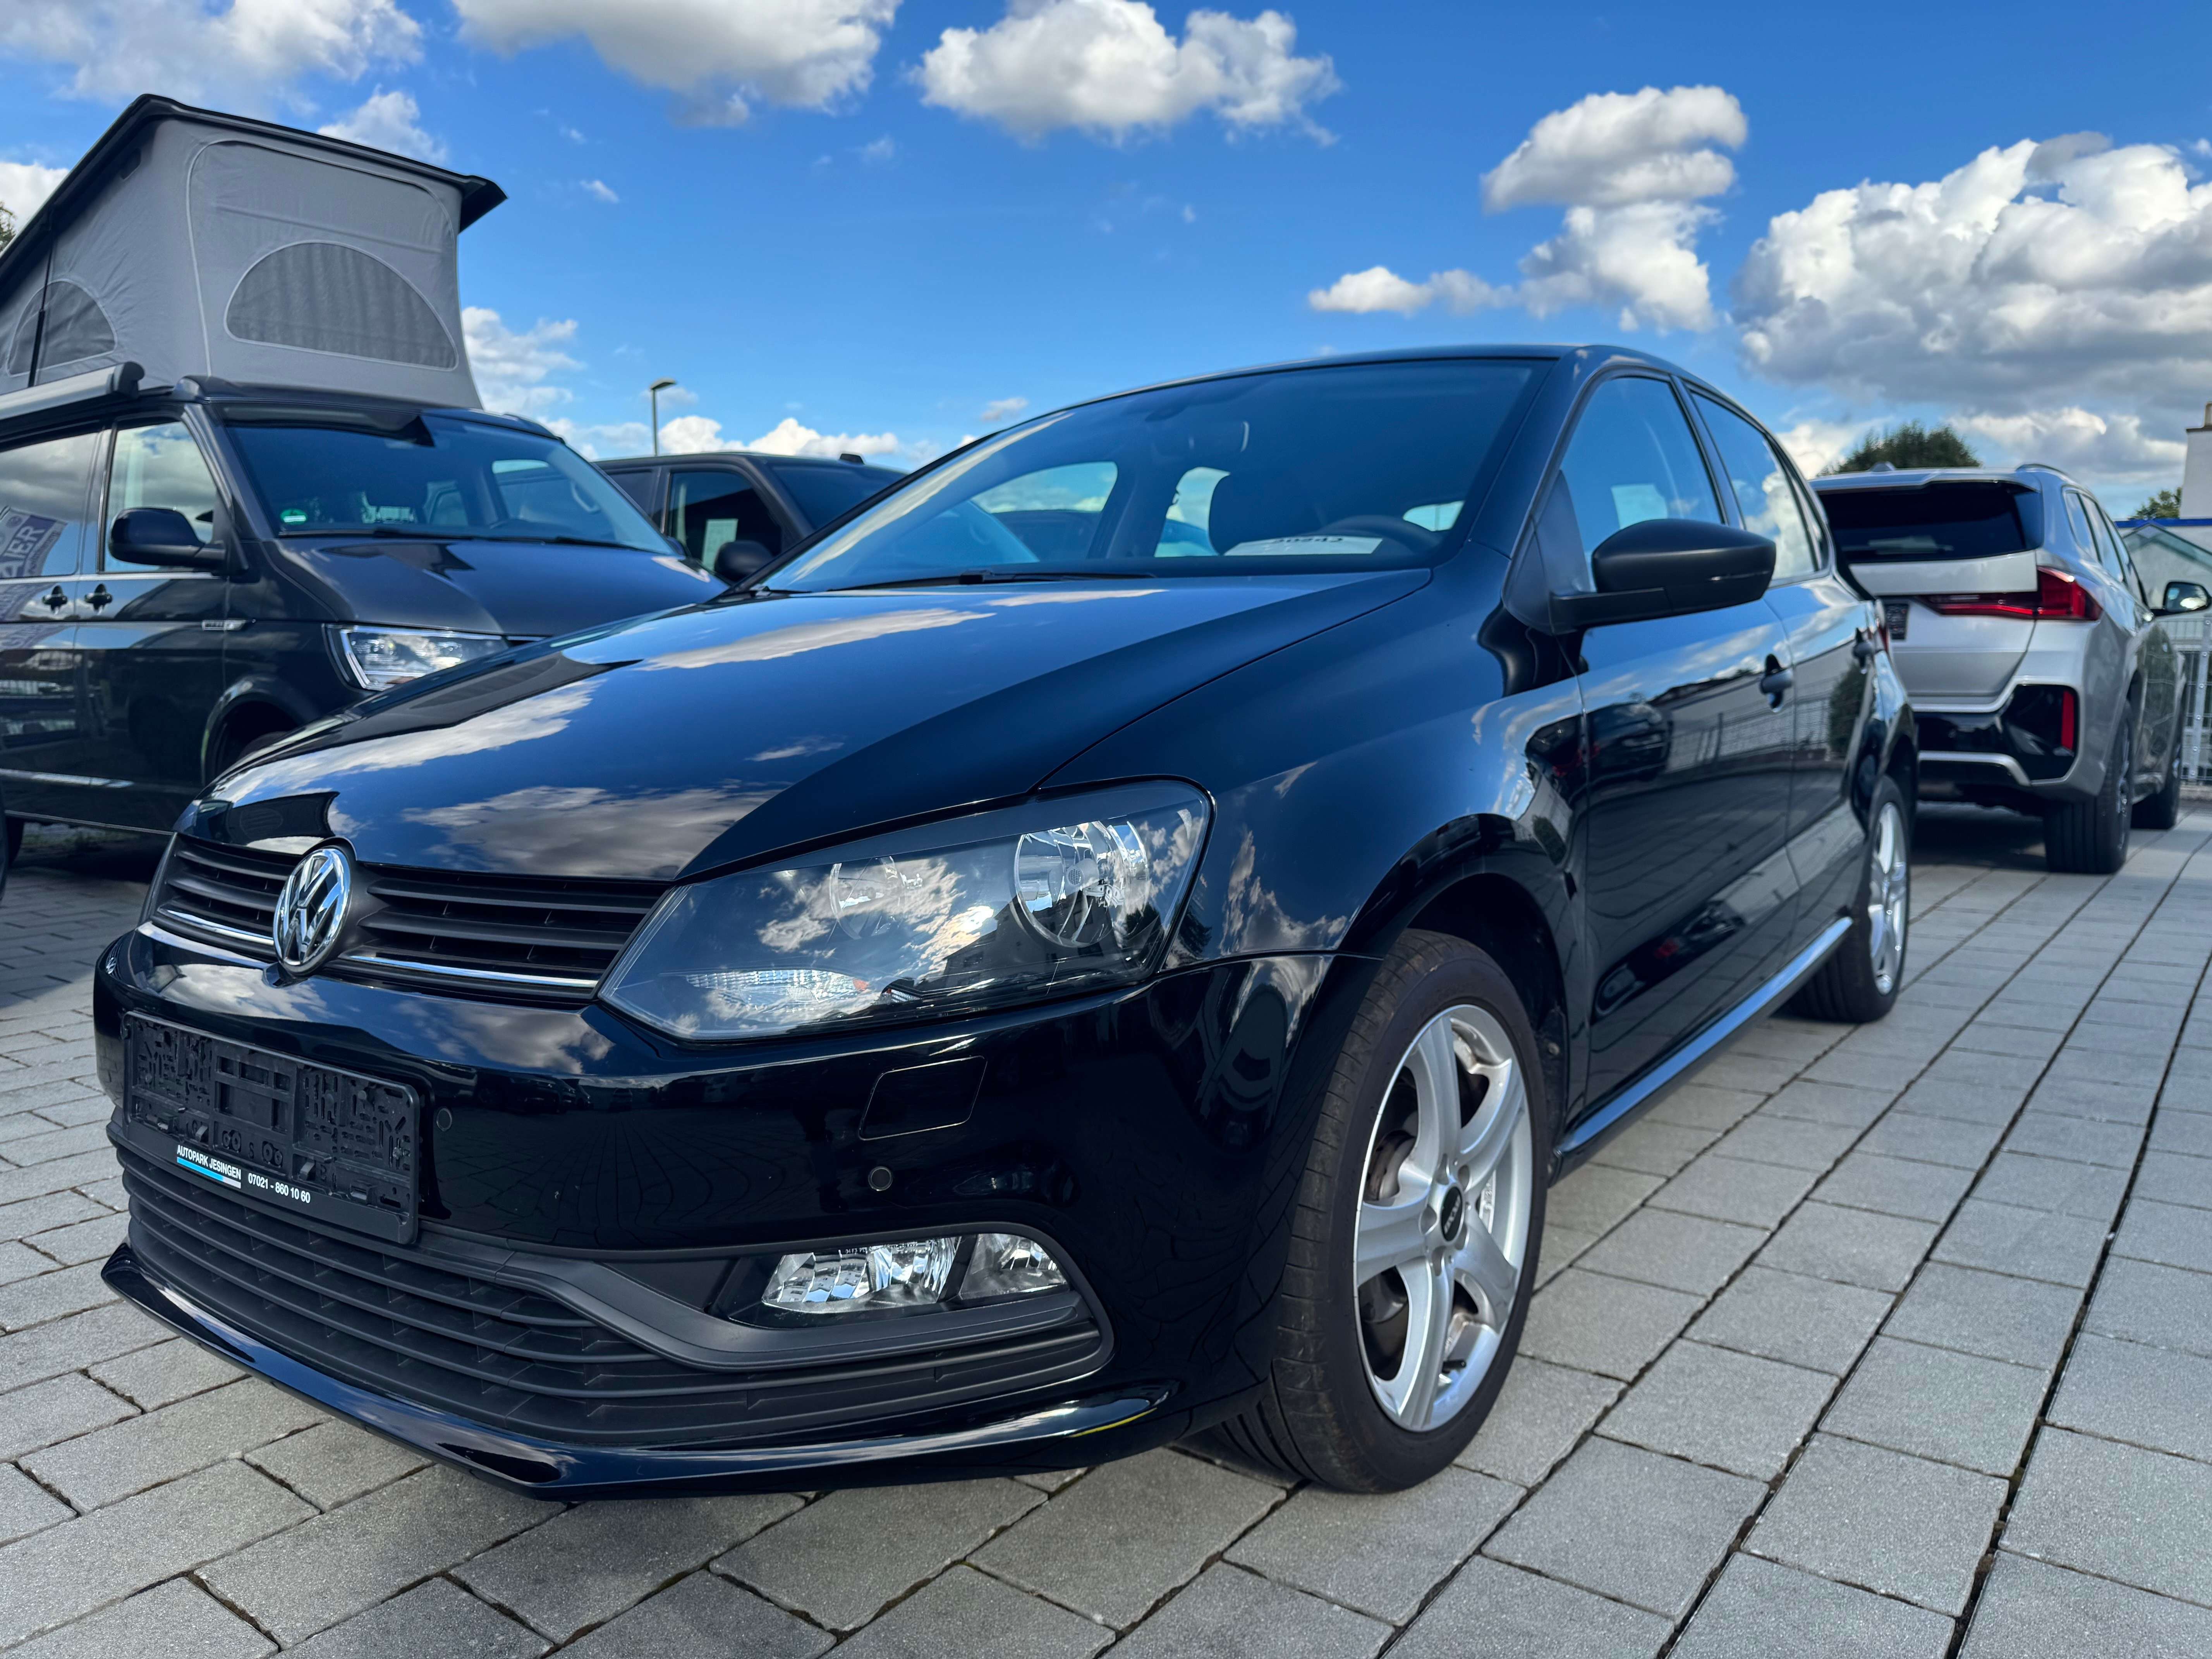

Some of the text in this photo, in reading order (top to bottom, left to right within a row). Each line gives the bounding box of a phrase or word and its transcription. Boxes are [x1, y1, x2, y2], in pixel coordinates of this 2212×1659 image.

[177, 1145, 208, 1167] AUTOPARK
[209, 1158, 241, 1180] JESINGEN
[248, 1173, 268, 1189] 07021
[275, 1182, 289, 1196] 860
[290, 1187, 300, 1200] 10
[301, 1190, 311, 1204] 60
